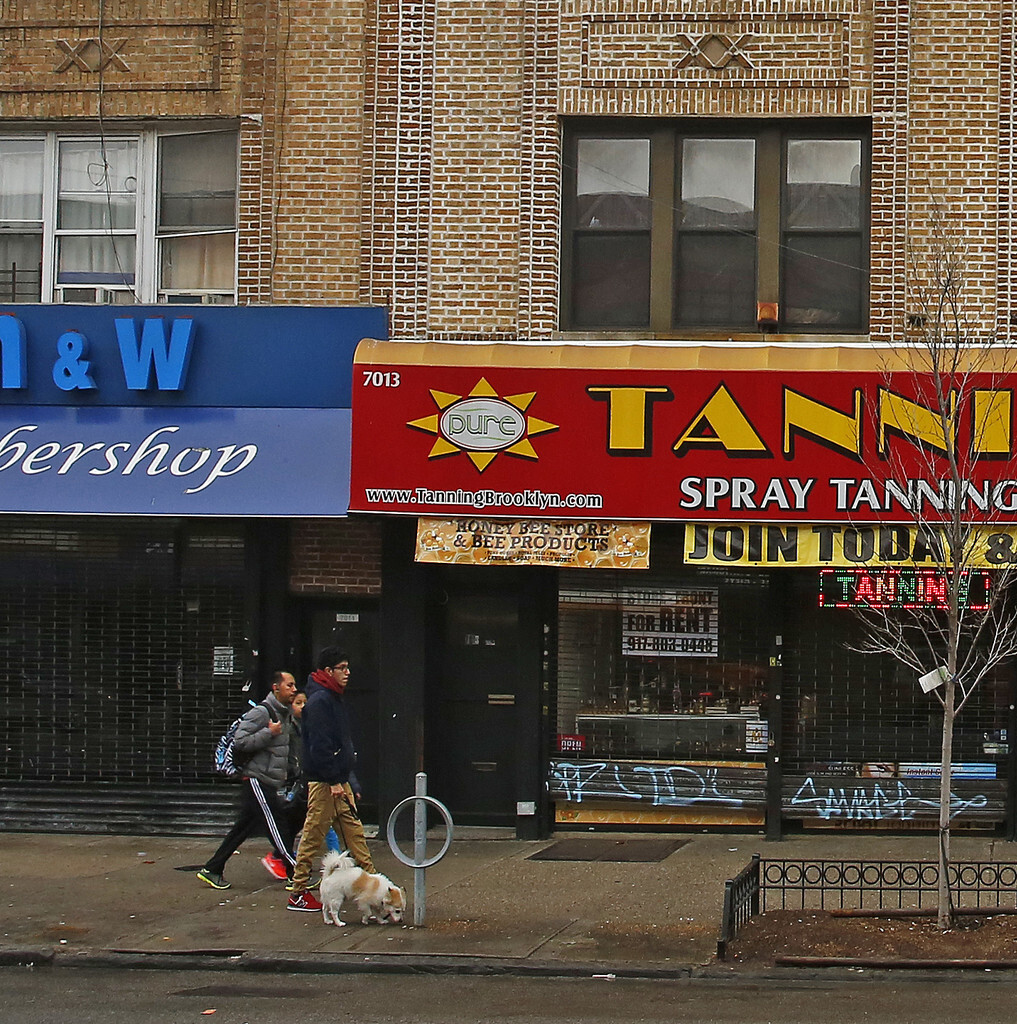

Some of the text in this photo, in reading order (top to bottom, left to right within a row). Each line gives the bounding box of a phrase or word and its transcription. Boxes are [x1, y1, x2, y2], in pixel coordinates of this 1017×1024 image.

[53, 329, 97, 391] &
[114, 315, 196, 391] W
[362, 371, 400, 388] 7013
[448, 412, 517, 436] pure
[365, 488, 603, 509] www.TanningBrooklyn.com
[679, 477, 815, 510] SPRAY
[455, 520, 611, 537] HONEY BEE STORE
[454, 534, 610, 552] & BEE PRODUCTS
[689, 526, 798, 563] JOIN
[836, 576, 969, 602] TANNING
